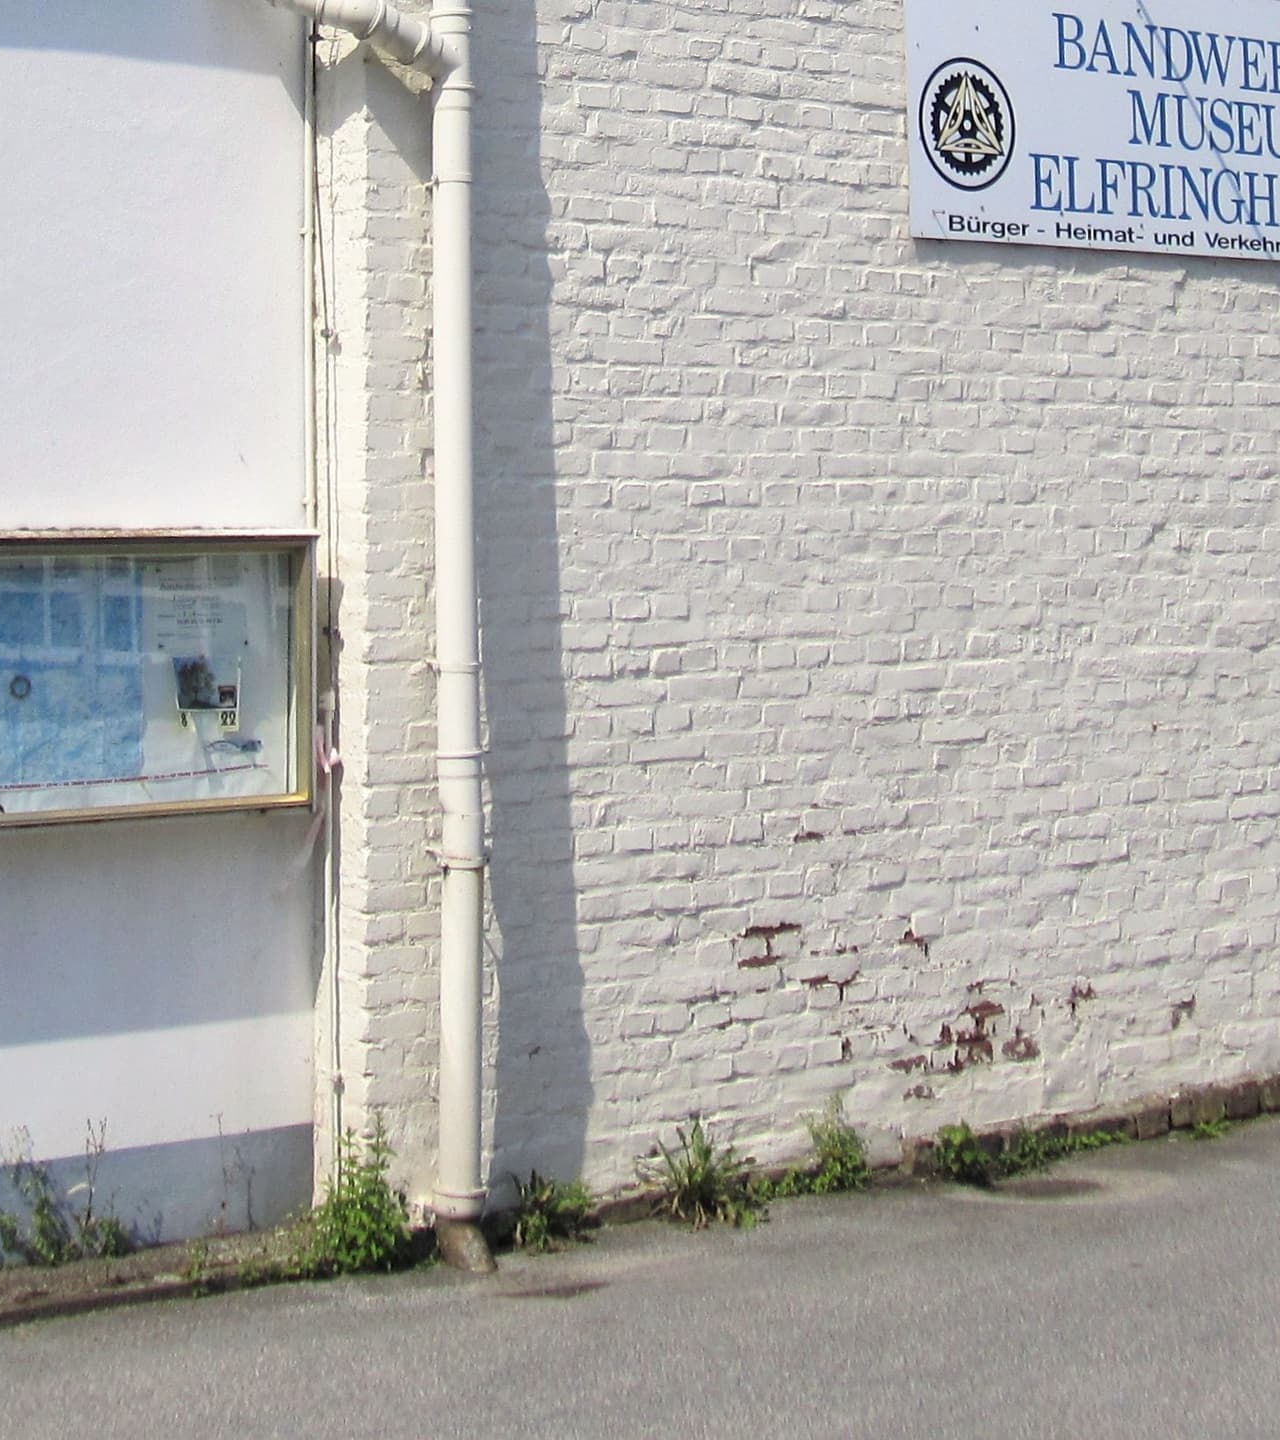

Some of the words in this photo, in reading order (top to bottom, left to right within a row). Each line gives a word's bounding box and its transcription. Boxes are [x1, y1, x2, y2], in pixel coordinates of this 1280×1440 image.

[948, 214, 1029, 239] Bürger
[1056, 222, 1144, 244] Heimat-
[1154, 231, 1195, 247] und
[221, 711, 236, 726] 22
